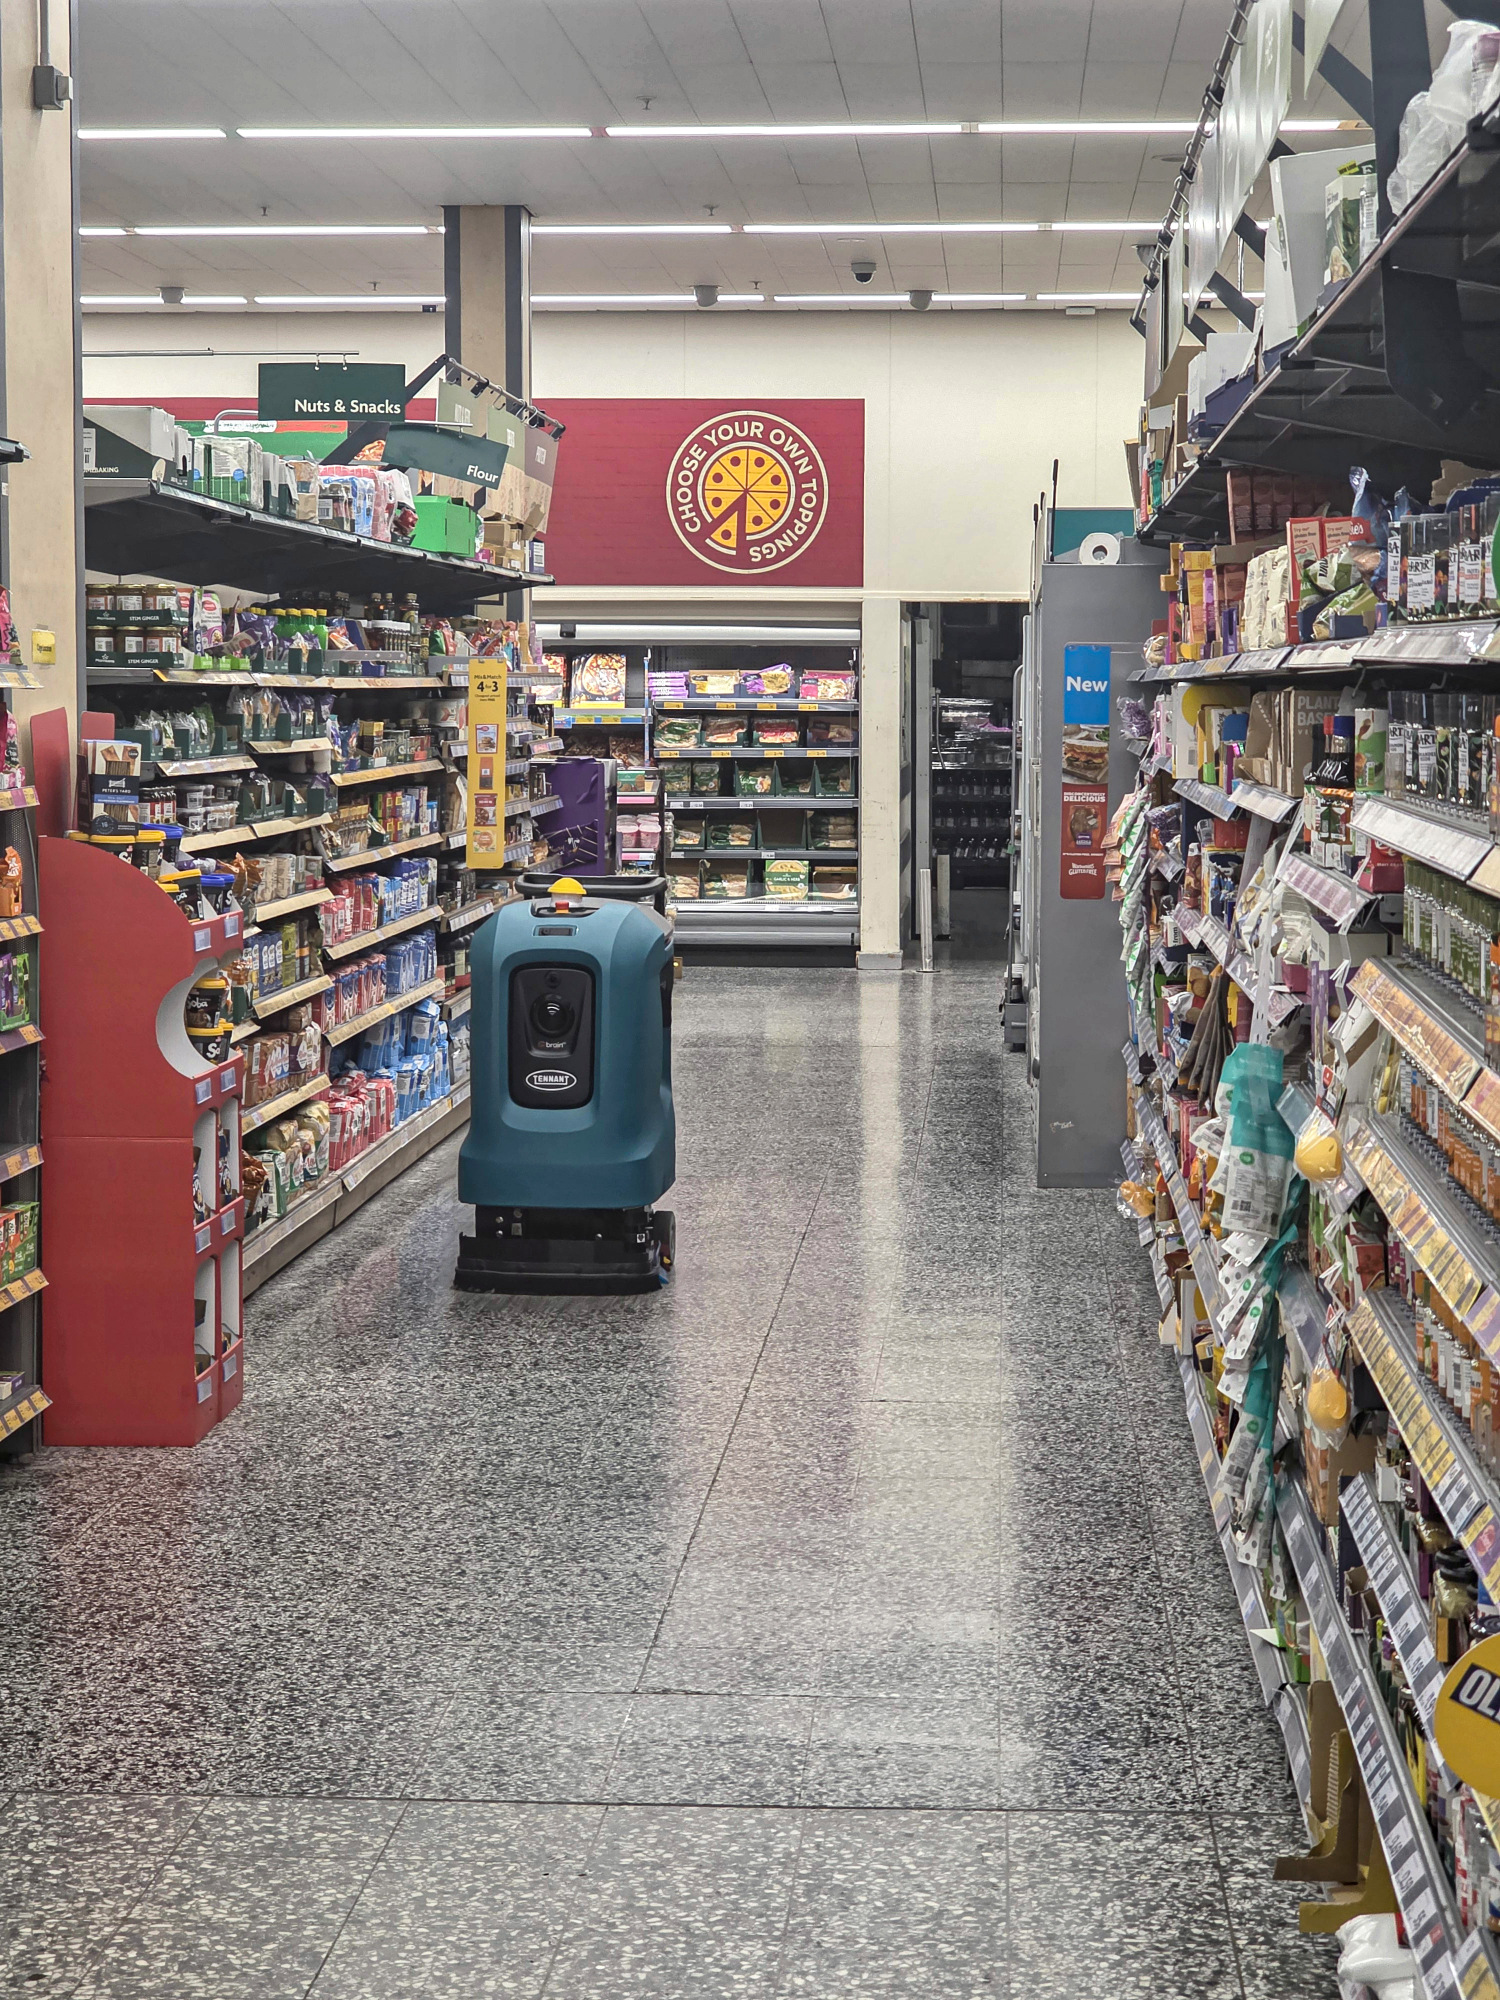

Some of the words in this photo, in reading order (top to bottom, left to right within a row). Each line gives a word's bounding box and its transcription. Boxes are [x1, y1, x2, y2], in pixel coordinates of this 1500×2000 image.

[294, 399, 330, 413] Nuts
[334, 399, 346, 413] &
[350, 399, 401, 414] Snacks
[703, 421, 764, 447] YOUR
[769, 429, 813, 475] OWN
[466, 464, 499, 483] Flour
[676, 443, 707, 533] CHOOSE
[749, 478, 817, 562] TOPPINGS
[477, 681, 485, 692] 4
[492, 681, 499, 692] 3
[1066, 676, 1108, 692] New
[533, 1075, 569, 1083] TENNANT
[1458, 1668, 1500, 1722] OL
